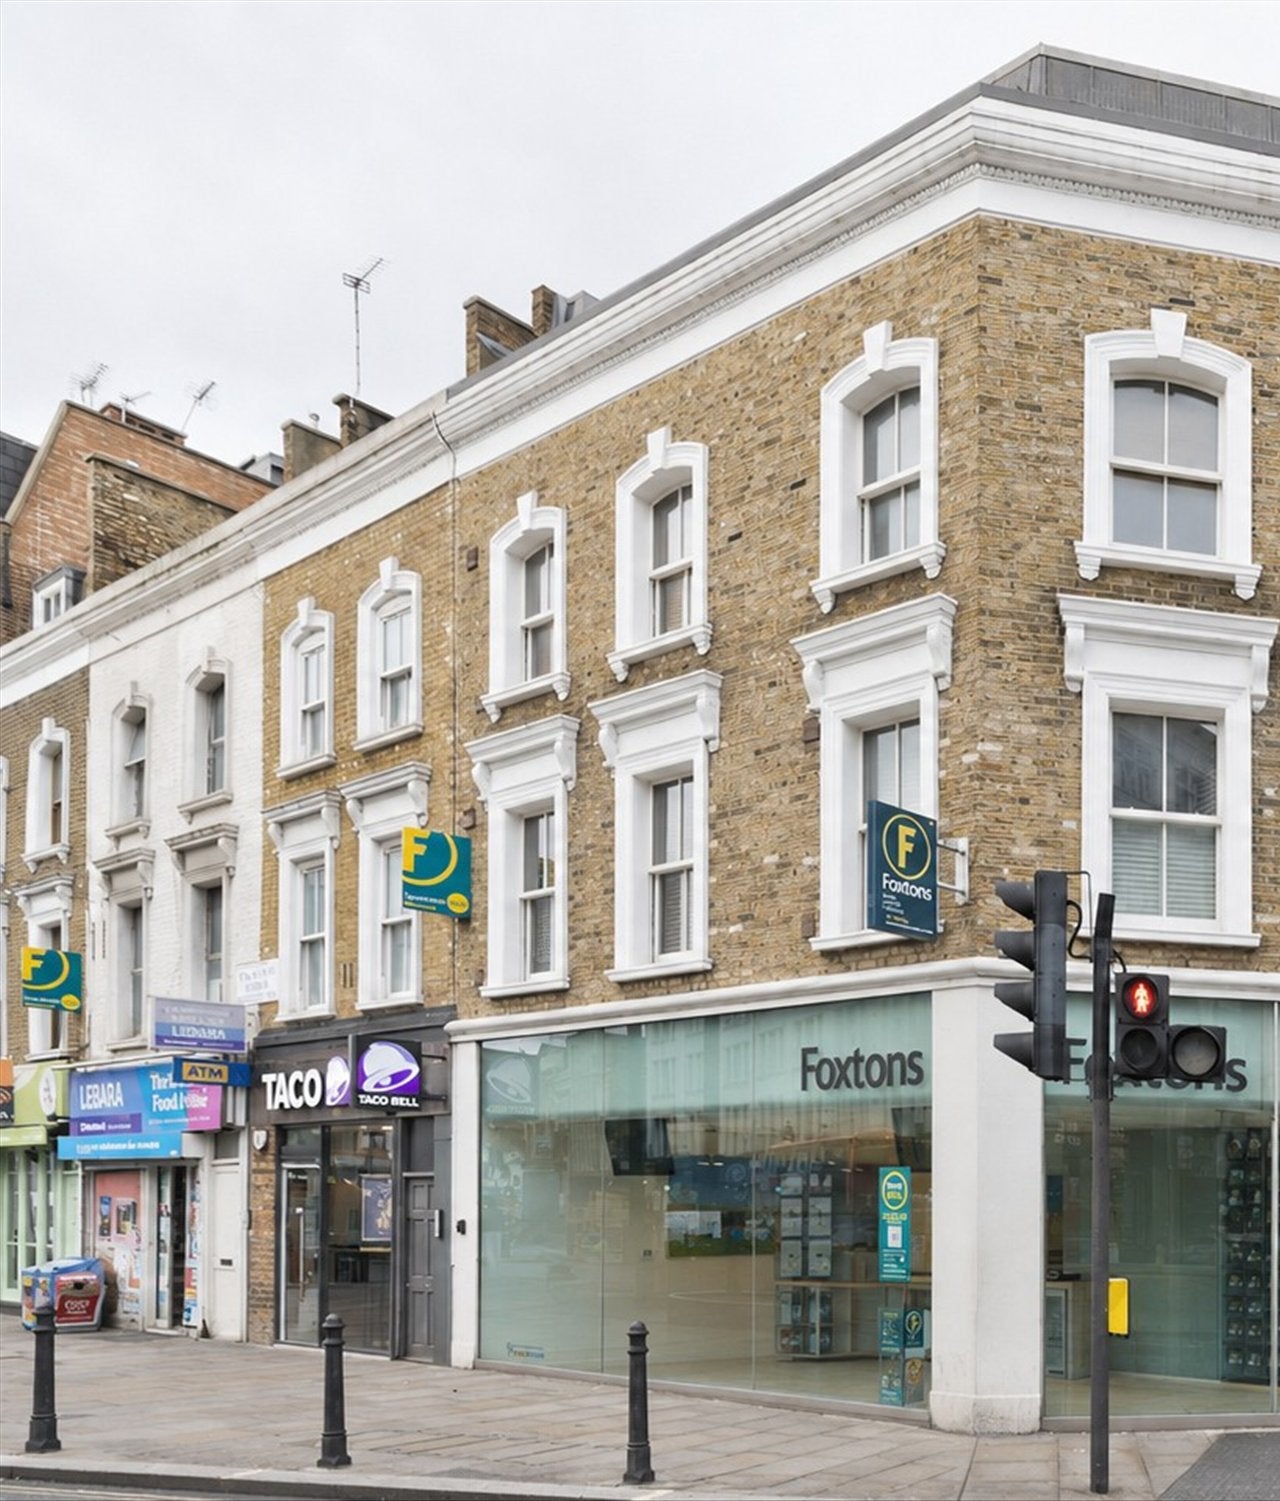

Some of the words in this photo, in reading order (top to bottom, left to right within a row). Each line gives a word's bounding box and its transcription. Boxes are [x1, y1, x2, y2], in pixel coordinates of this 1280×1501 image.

[882, 872, 932, 901] Foxtons
[188, 1065, 223, 1079] ATM
[801, 1047, 924, 1091] Foxtons
[79, 1082, 124, 1111] LEBARA
[152, 1092, 178, 1112] Food
[261, 1068, 322, 1110] TACO
[358, 1094, 388, 1105] TACO
[391, 1098, 419, 1107] BELL
